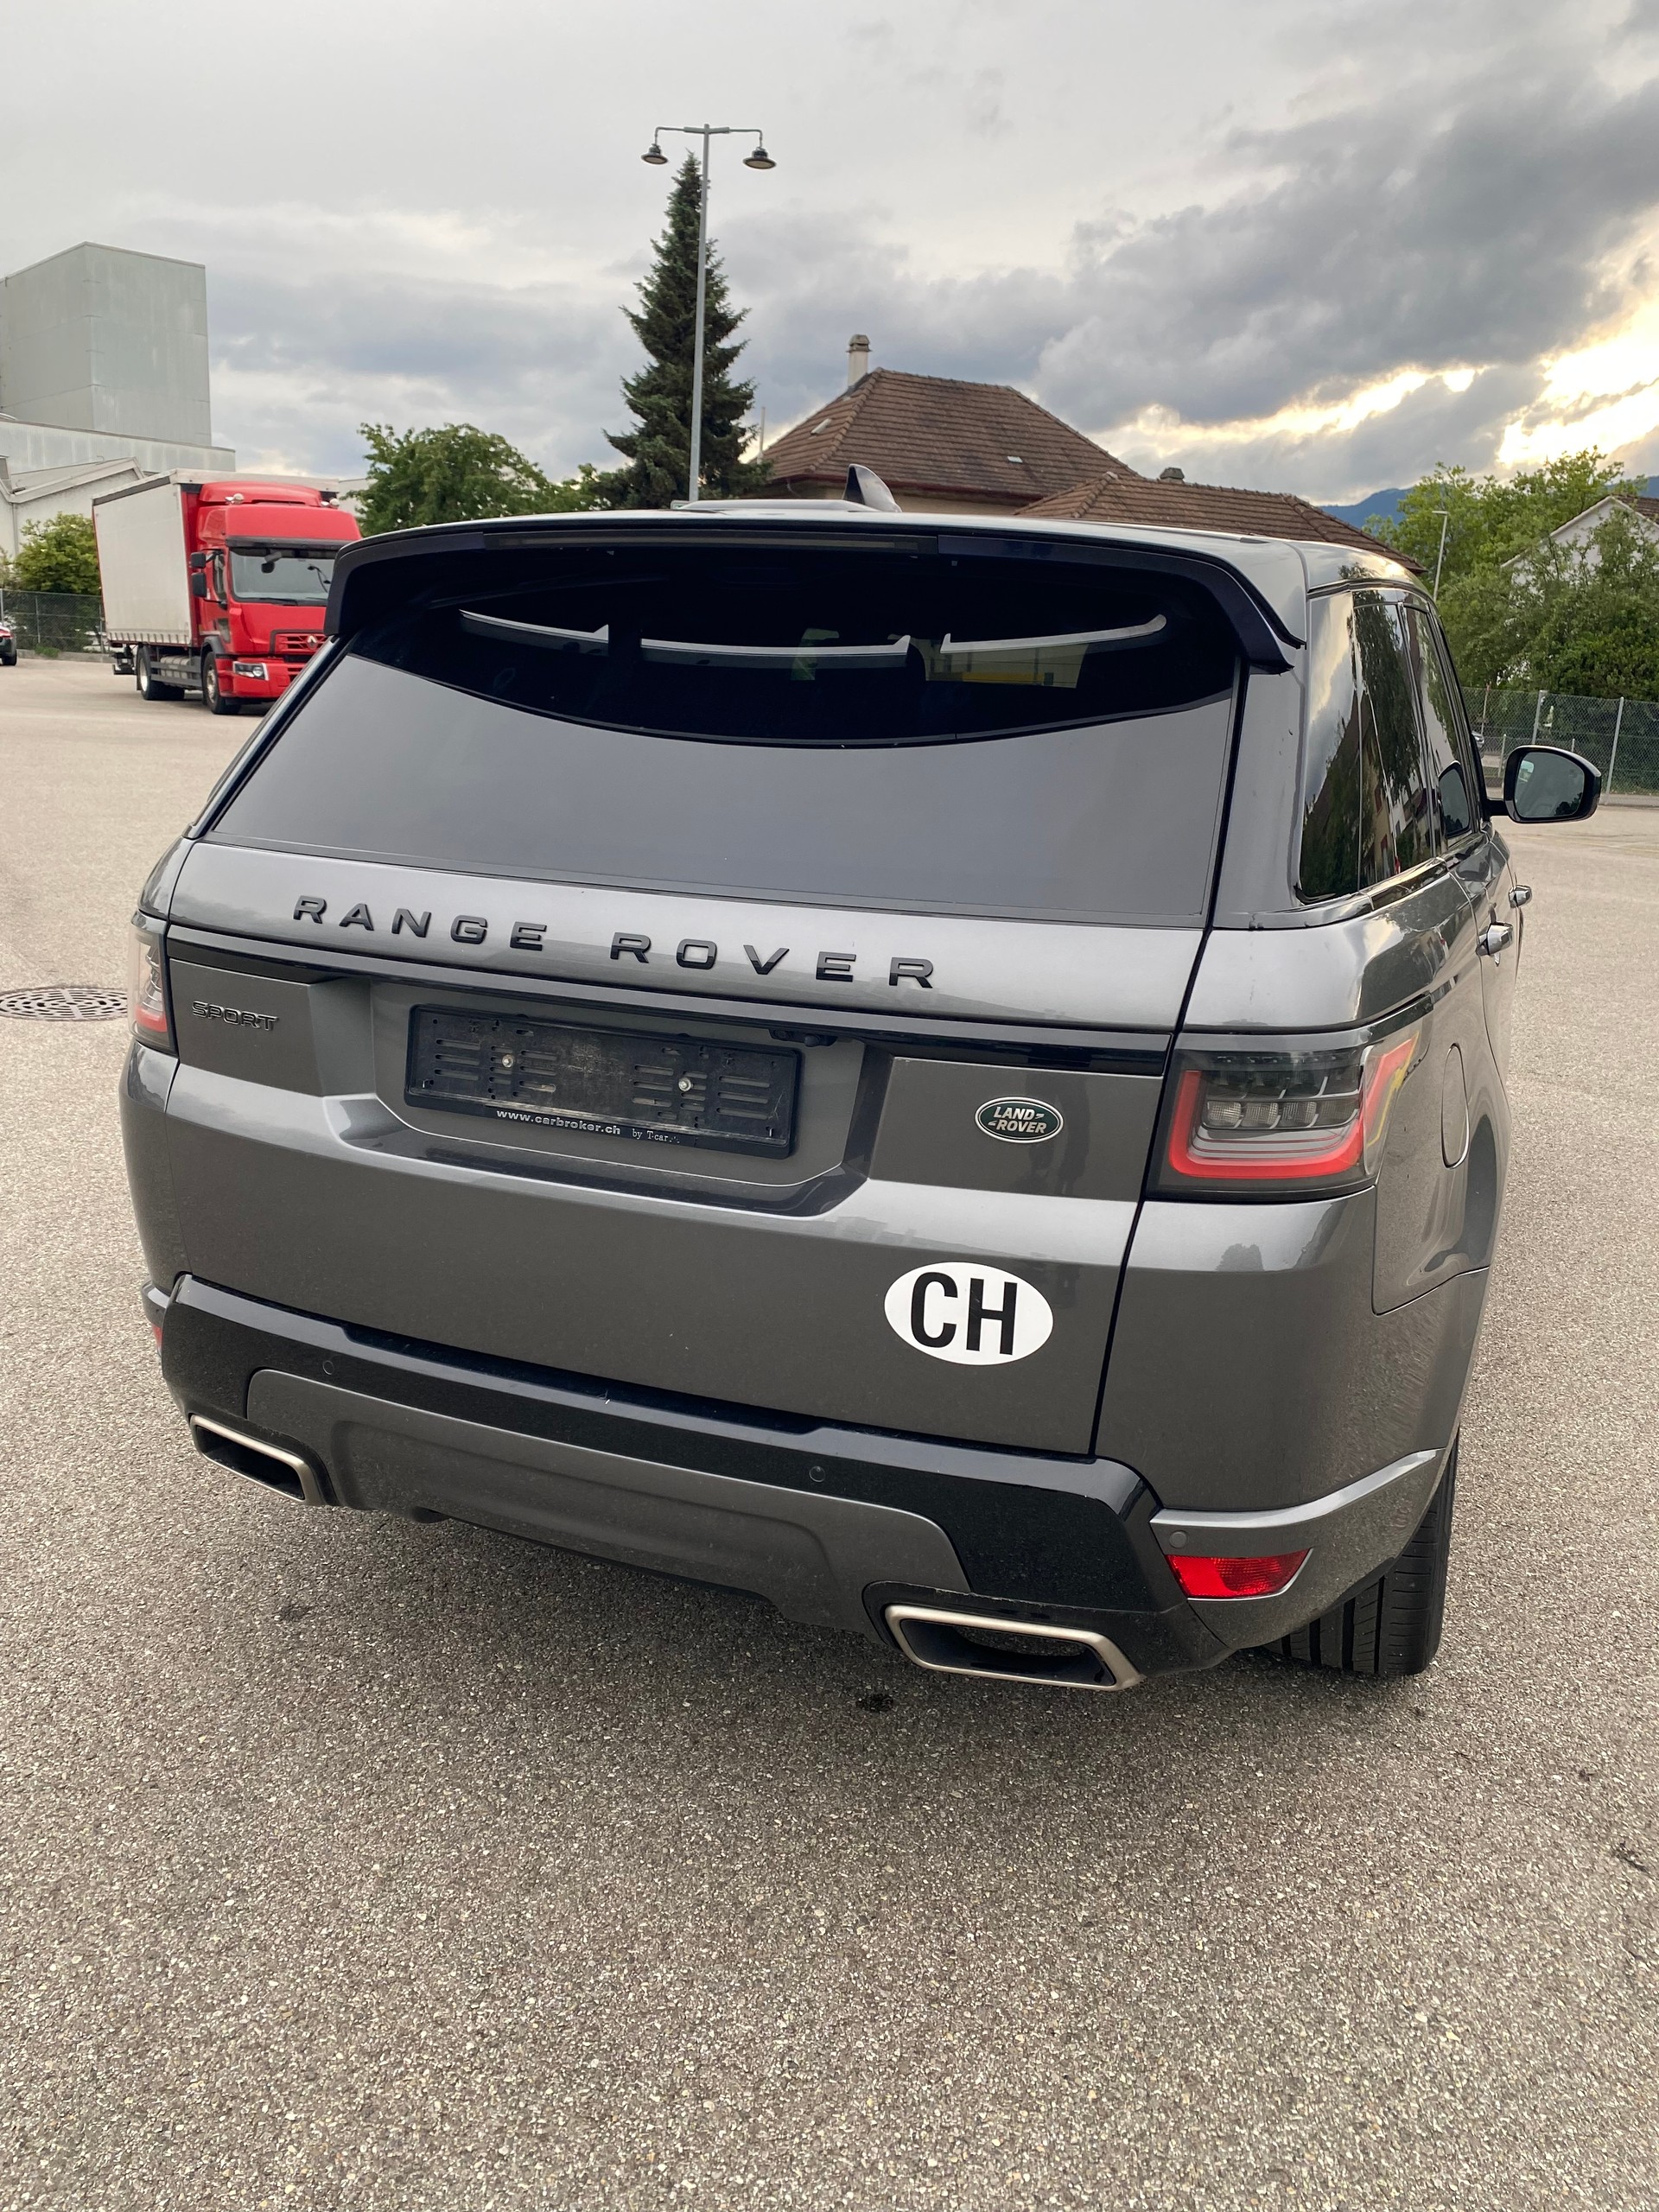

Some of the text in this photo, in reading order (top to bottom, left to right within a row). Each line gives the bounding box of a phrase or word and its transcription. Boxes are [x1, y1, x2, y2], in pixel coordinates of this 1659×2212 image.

[293, 895, 934, 989] RANGE ROVER
[192, 1001, 279, 1031] SPORT
[496, 1109, 621, 1135] www.carbroker.ch
[632, 1128, 643, 1140] by
[993, 1106, 1035, 1121] LAND
[996, 1119, 1047, 1134] ROVER
[911, 1271, 1018, 1356] CH
